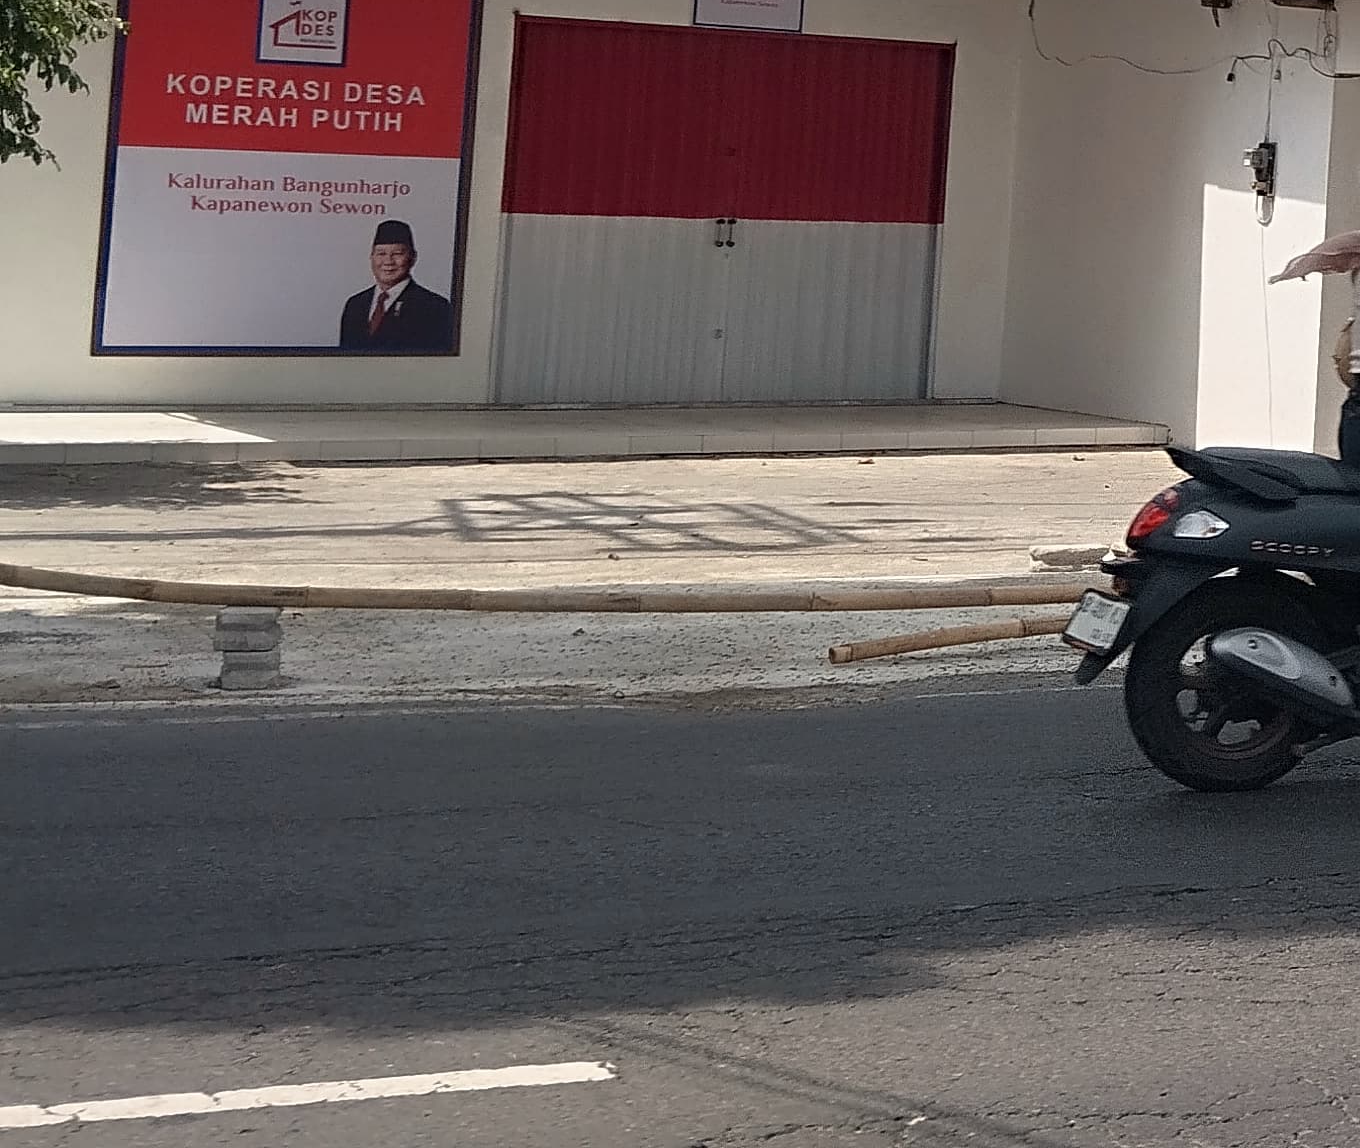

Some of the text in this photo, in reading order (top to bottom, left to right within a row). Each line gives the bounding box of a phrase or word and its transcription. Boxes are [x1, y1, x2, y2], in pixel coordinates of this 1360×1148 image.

[302, 9, 337, 22] KOP
[302, 24, 334, 36] DES
[166, 73, 425, 106] KOPERASI DESA
[184, 103, 403, 132] MERAH PUTIH
[168, 172, 411, 197] Kalurahan Bangunharjo
[191, 195, 386, 216] Kapanewon Sewon
